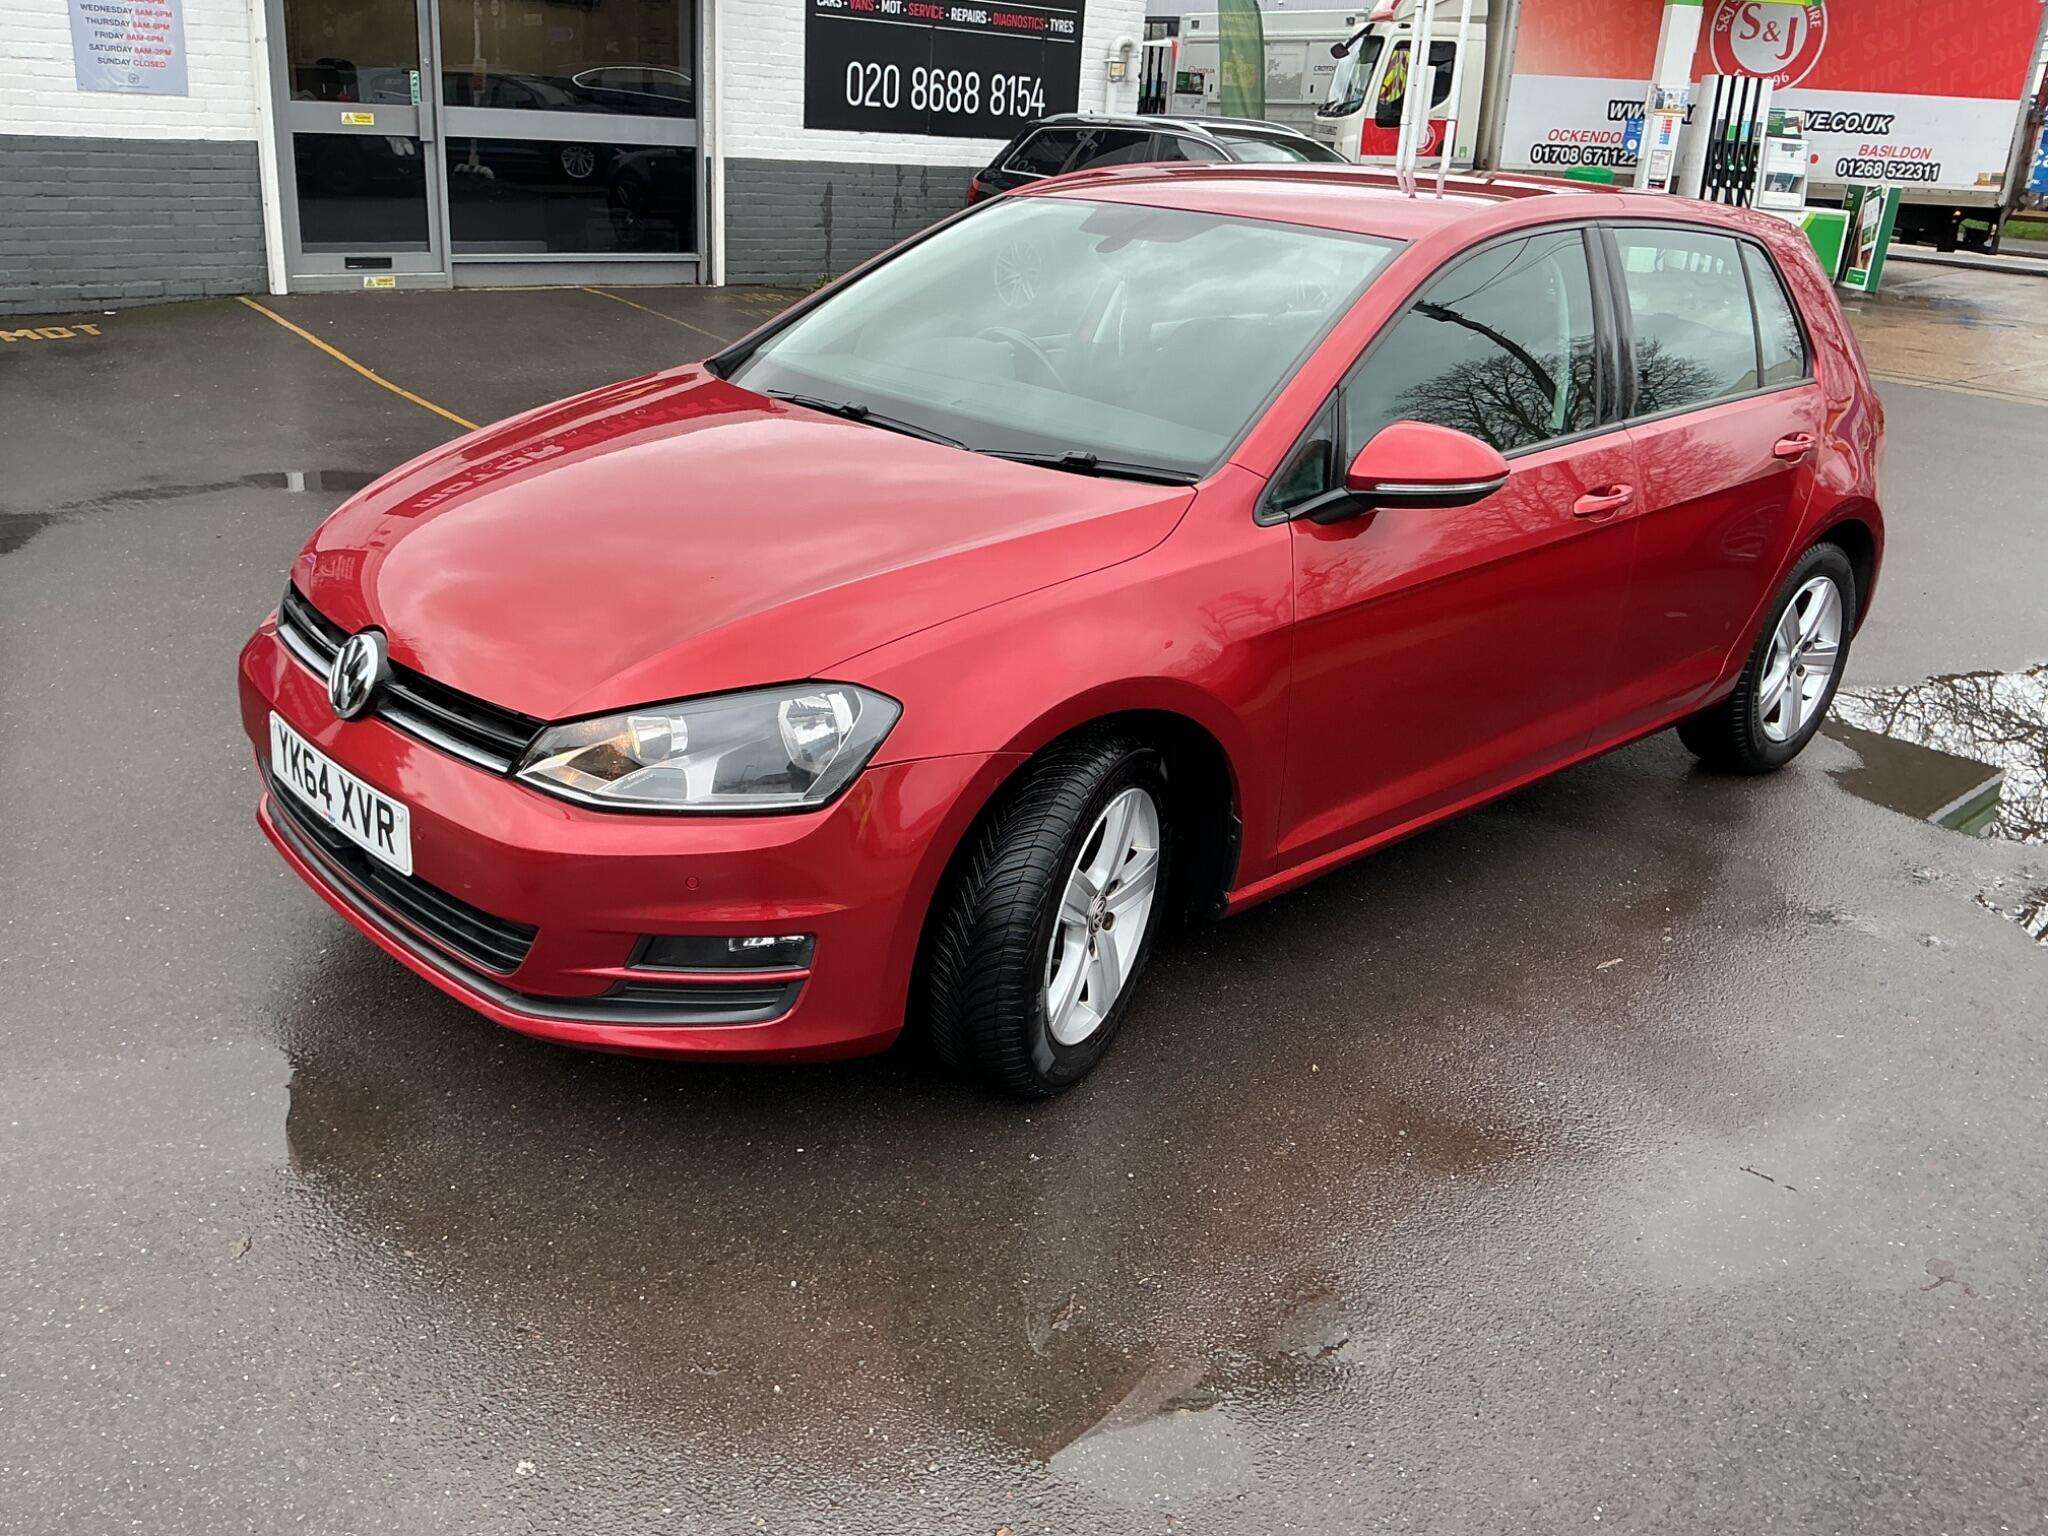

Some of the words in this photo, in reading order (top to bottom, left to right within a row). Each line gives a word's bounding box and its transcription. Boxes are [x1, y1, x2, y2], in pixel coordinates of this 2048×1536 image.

[80, 3, 132, 14] WEDNESDAY
[850, 0, 874, 11] VANS
[881, 0, 902, 14] MOT
[908, 2, 944, 19] SERVICE
[951, 7, 987, 24] REPAIRS
[992, 12, 1044, 30] DIAGNOSTICS
[1050, 18, 1074, 33] TYRES
[1806, 5, 1821, 29] IRE
[85, 17, 130, 27] THURSDAY
[94, 30, 124, 40] FRIDAY
[88, 43, 132, 54] SATURDAY
[97, 57, 131, 66] SUNDAY
[133, 60, 167, 69] CLOSED
[846, 61, 900, 109] 020
[911, 66, 980, 114] 8688
[990, 73, 1046, 118] 8154
[1804, 111, 1894, 134] VE.CO.UK
[1547, 128, 1622, 145] OCKENDO
[1530, 144, 1579, 164] 01708
[1582, 148, 1637, 167] 671122
[1858, 144, 1932, 160] BASILDON
[1836, 158, 1884, 178] 01268
[1886, 163, 1940, 181] 522311
[0, 323, 102, 342] MOT
[278, 724, 333, 811] YK64
[339, 774, 396, 856] XVR
